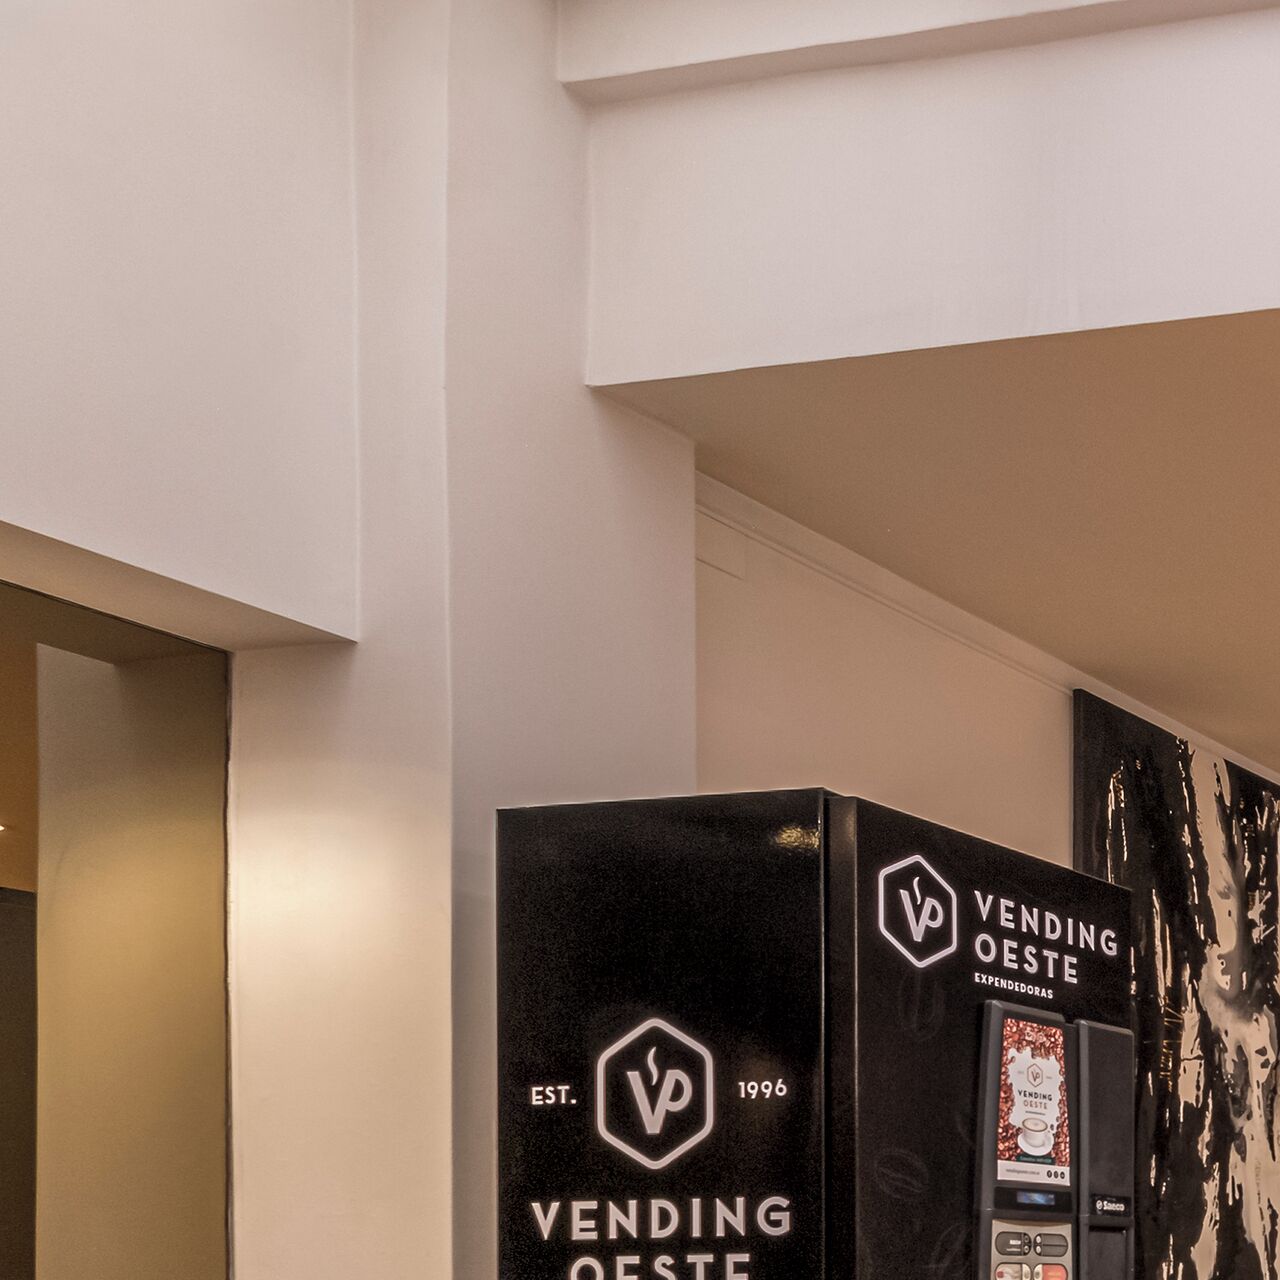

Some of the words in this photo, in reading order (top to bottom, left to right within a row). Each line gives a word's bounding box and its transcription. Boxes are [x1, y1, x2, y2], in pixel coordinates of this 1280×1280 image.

[974, 890, 1118, 956] VENDING
[974, 933, 1078, 984] OESTE
[974, 972, 1054, 999] EXPENDEDORAS
[531, 1085, 577, 1105] EST.
[738, 1079, 787, 1099] 1996
[1017, 1090, 1053, 1101] VENDING
[1023, 1100, 1048, 1110] OESTE
[531, 1196, 790, 1240] VENDING
